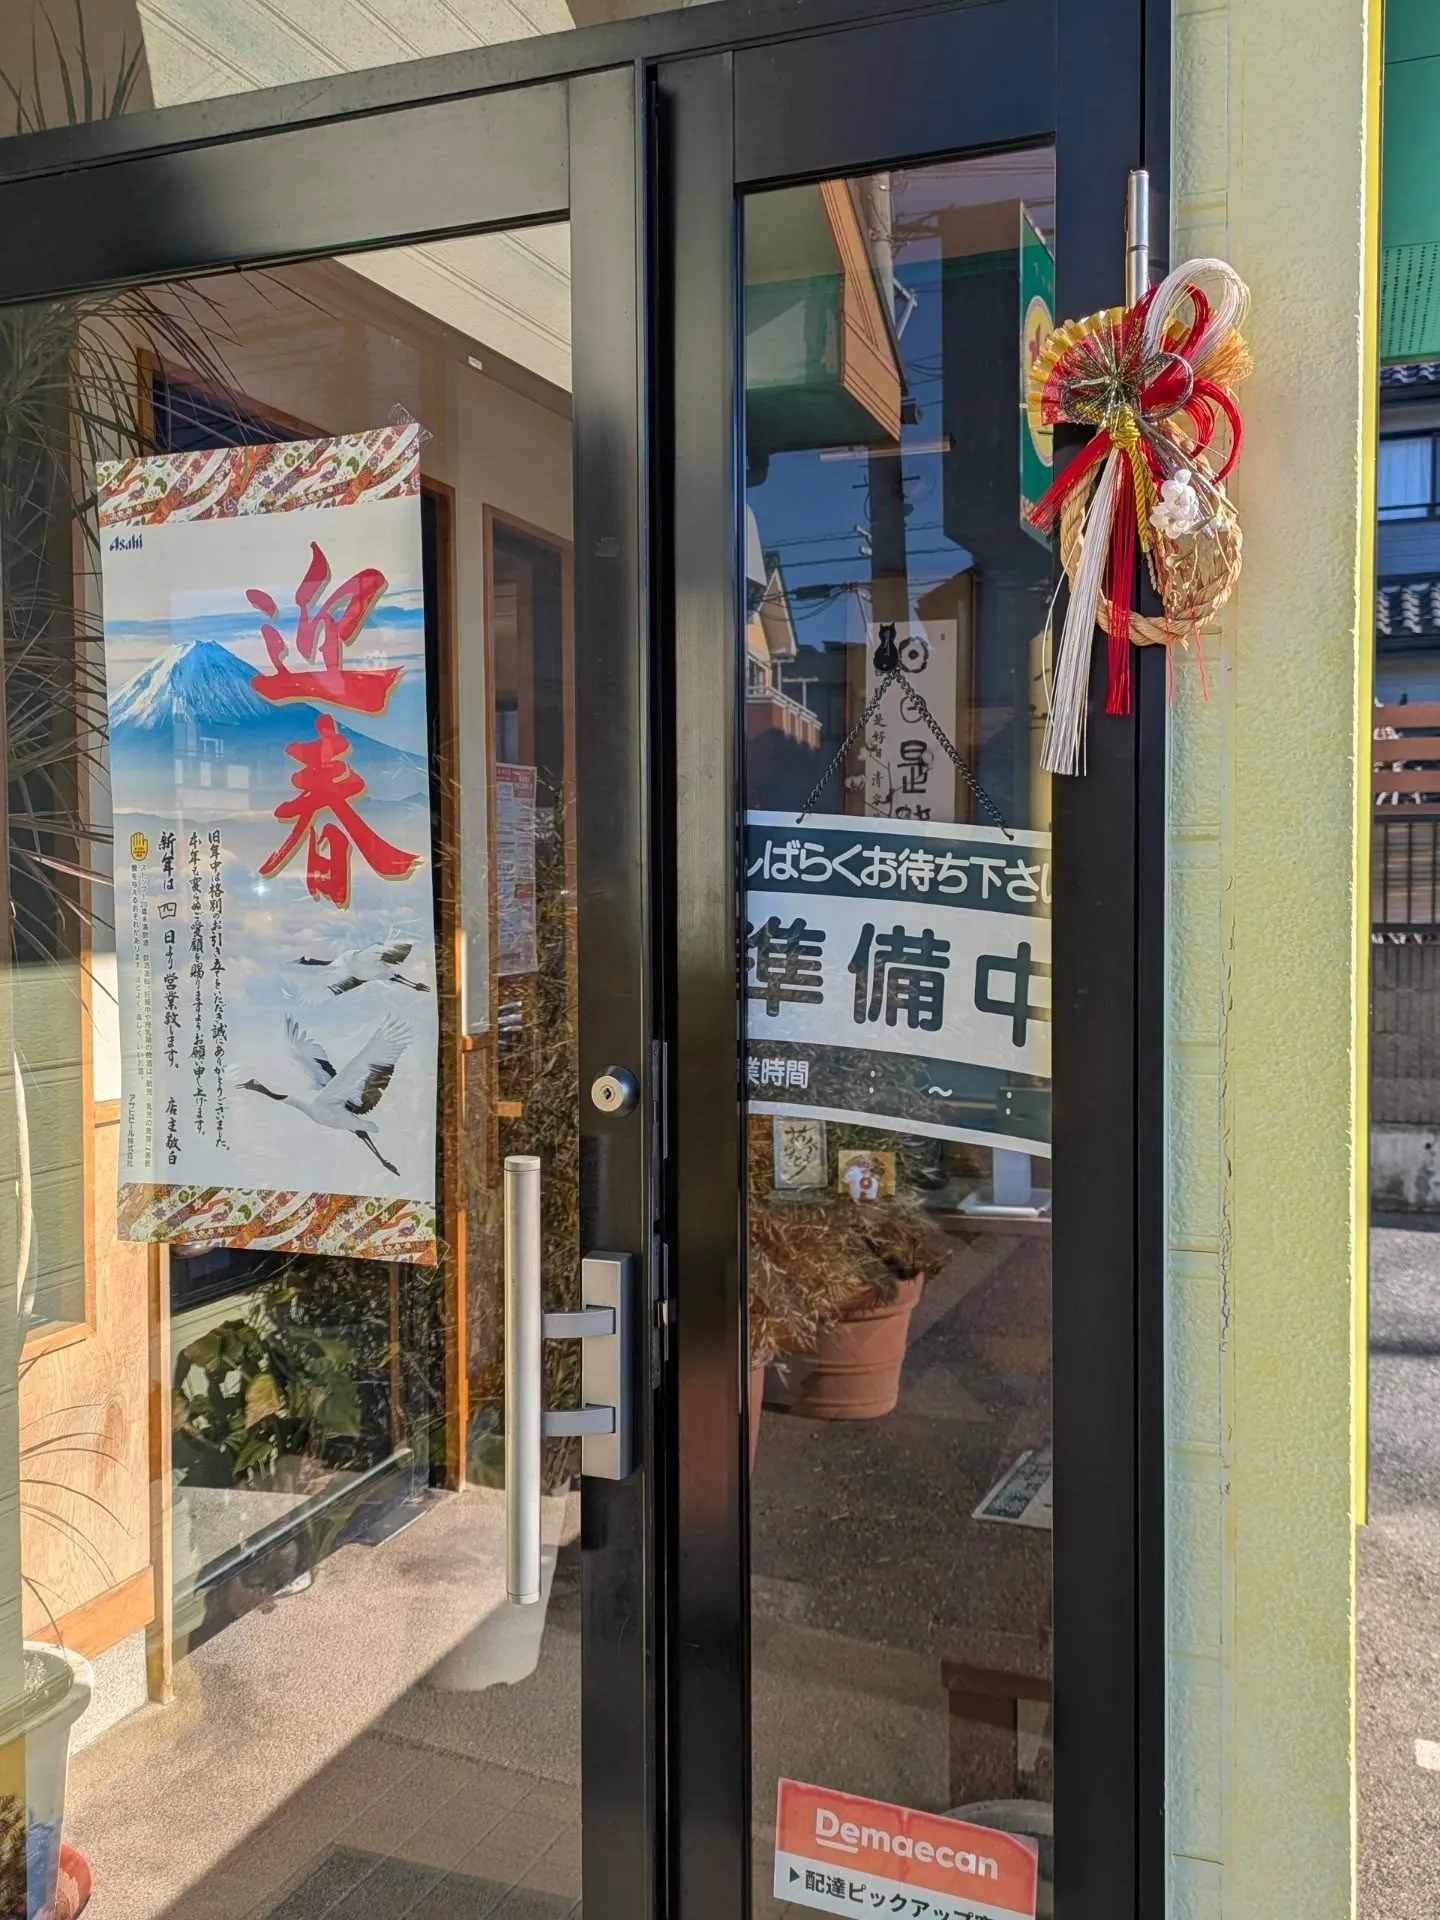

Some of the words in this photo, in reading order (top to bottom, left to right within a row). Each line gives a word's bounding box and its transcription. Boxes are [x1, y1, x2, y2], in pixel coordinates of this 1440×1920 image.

[109, 534, 143, 552] Asahi
[246, 541, 422, 908] 迎春
[746, 916, 1052, 1047] 準備中
[165, 1097, 181, 1165] 店主敬白
[816, 1807, 999, 1881] Demaecan
